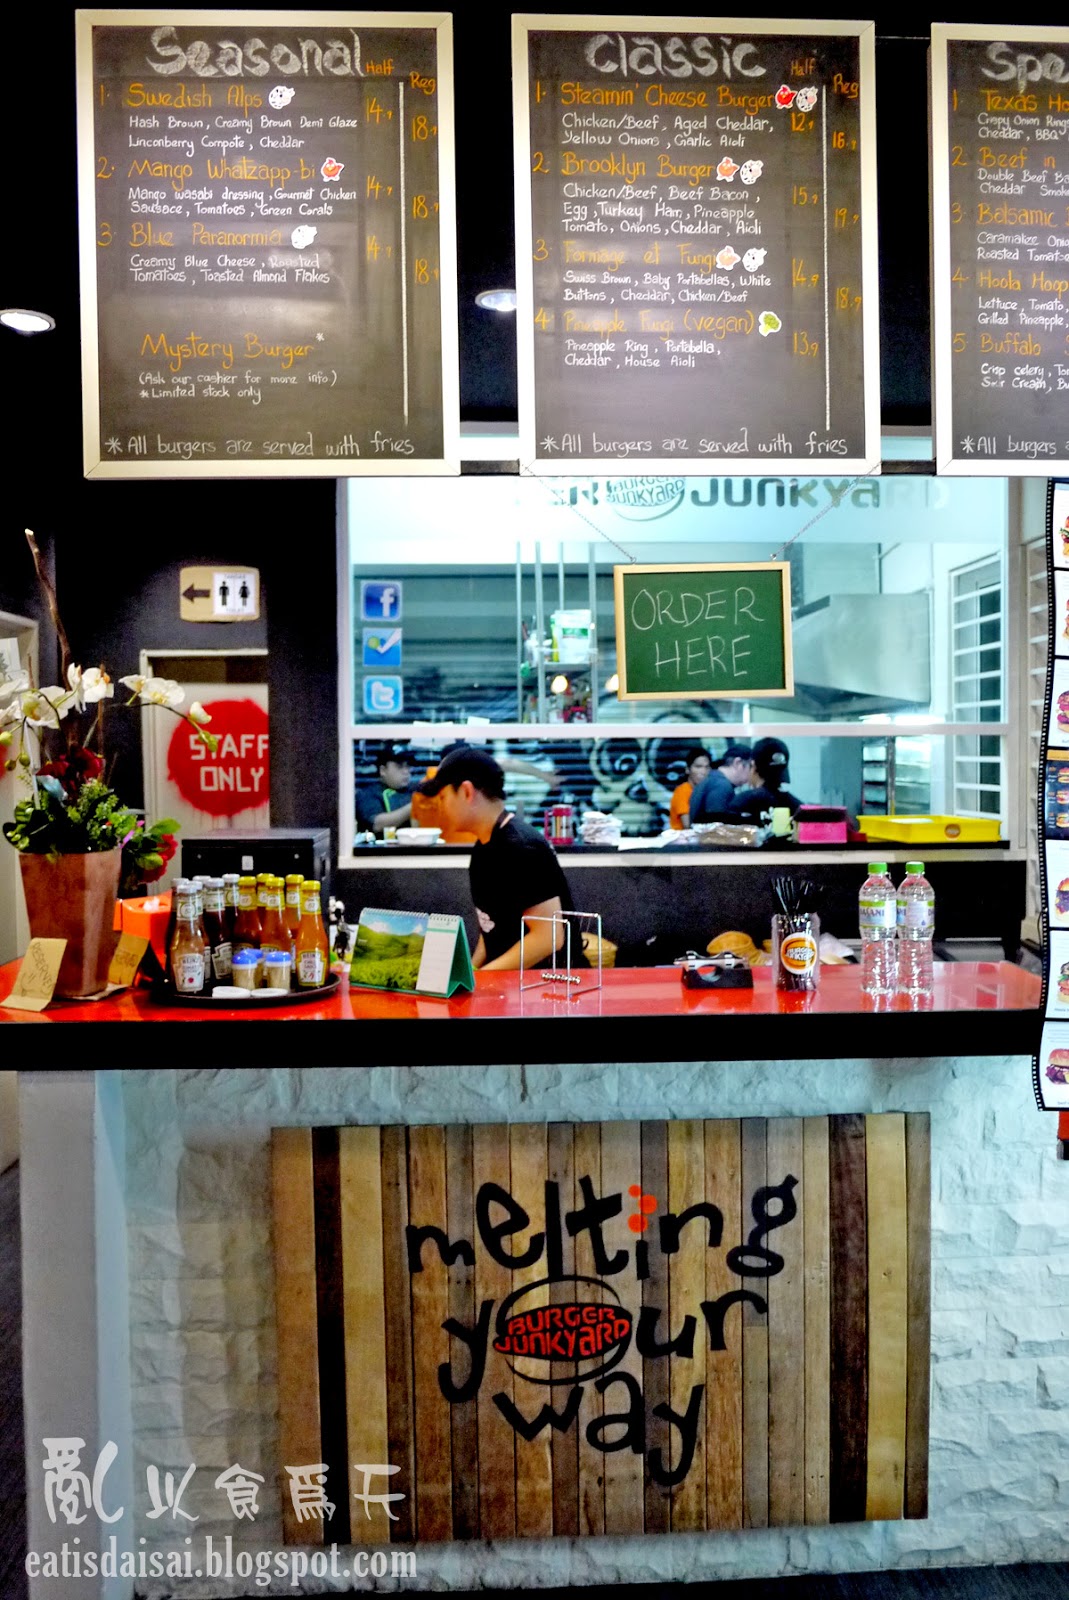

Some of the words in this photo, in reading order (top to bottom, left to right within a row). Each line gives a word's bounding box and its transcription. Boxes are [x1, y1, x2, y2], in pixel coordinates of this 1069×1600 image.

[146, 26, 366, 77] Seasonal
[586, 34, 767, 78] Classic
[366, 58, 394, 75] Half
[409, 71, 436, 95] Reg
[791, 57, 816, 76] Half
[833, 73, 859, 98] Reg
[128, 82, 212, 108] Swedish
[227, 85, 263, 118] Alps
[645, 84, 709, 107] Cheese
[716, 85, 774, 116] Burger
[980, 89, 1038, 112] Texas
[129, 115, 159, 128] Hash
[215, 115, 253, 134] Creamy
[260, 115, 292, 129] Brown
[300, 116, 323, 128] Demi
[329, 116, 358, 128] Glaze
[674, 115, 707, 137] Aged
[977, 112, 1009, 129] Crispy
[1013, 114, 1040, 126] Onion
[260, 135, 305, 148] Cheddar
[561, 130, 612, 144] Yellow
[674, 132, 712, 147] Garlic
[1035, 129, 1059, 141] BBQ
[561, 151, 646, 184] Brooklyn
[656, 154, 715, 187] Burger
[979, 146, 1028, 169] Beef
[128, 159, 193, 191] Mango
[977, 168, 1014, 181] Double
[1021, 169, 1048, 183] Beef
[128, 187, 166, 205] Mango
[174, 187, 213, 200] wasabi
[274, 187, 314, 200] Gourmet
[320, 187, 357, 200] Chicken
[668, 185, 704, 200] Beef
[980, 182, 1026, 195] Cheddar
[260, 203, 292, 216] Green
[298, 203, 333, 216] Corals
[597, 201, 643, 224] Turkey
[693, 204, 755, 224] Pineapple
[977, 201, 1058, 228] Balsamic
[129, 221, 174, 247] Blue
[192, 221, 282, 247] Paranormia
[736, 219, 762, 235] Aioli
[130, 254, 176, 270] Creamy
[184, 254, 208, 267] Blue
[268, 253, 320, 269] Roasted
[643, 241, 661, 264] et
[676, 242, 717, 274] Fungi
[977, 247, 1020, 260] Roasted
[200, 268, 244, 282] Toasted
[253, 268, 287, 282] Almond
[295, 268, 330, 283] Flakes
[562, 270, 597, 284] Swiss
[643, 272, 671, 290] Baby
[740, 274, 771, 287] White
[979, 269, 1021, 291] Hoola
[639, 309, 674, 340] Fungi
[683, 308, 755, 340] (vegan)
[977, 312, 1009, 325] Grilled
[141, 331, 234, 372] Mystery
[244, 332, 315, 369] Burger
[564, 339, 615, 356] Pineapple
[980, 332, 1041, 355] Buffalo
[624, 354, 660, 367] House
[670, 354, 695, 367] Aioli
[981, 362, 1006, 379] Crisp
[171, 374, 192, 386] our
[197, 371, 238, 384] cashier
[245, 370, 262, 385] for
[270, 375, 298, 385] more
[202, 384, 231, 398] stock
[237, 386, 262, 405] only
[158, 434, 216, 460] burgers
[226, 439, 252, 455] are
[262, 431, 314, 456] served
[326, 435, 360, 457] with
[370, 431, 415, 455] fries
[593, 432, 652, 458] burgers
[662, 438, 688, 450] are
[699, 427, 749, 453] served
[758, 433, 793, 454] with
[805, 431, 848, 455] fries
[1008, 435, 1057, 458] burgers
[631, 587, 765, 630] ORDER
[655, 634, 751, 678] HERE
[190, 733, 269, 761] STAFF
[200, 766, 265, 792] ONLY
[405, 1174, 799, 1281] melting
[507, 1306, 616, 1335] BURGER
[494, 1319, 631, 1358] JUNKYARD
[492, 1371, 704, 1486] way
